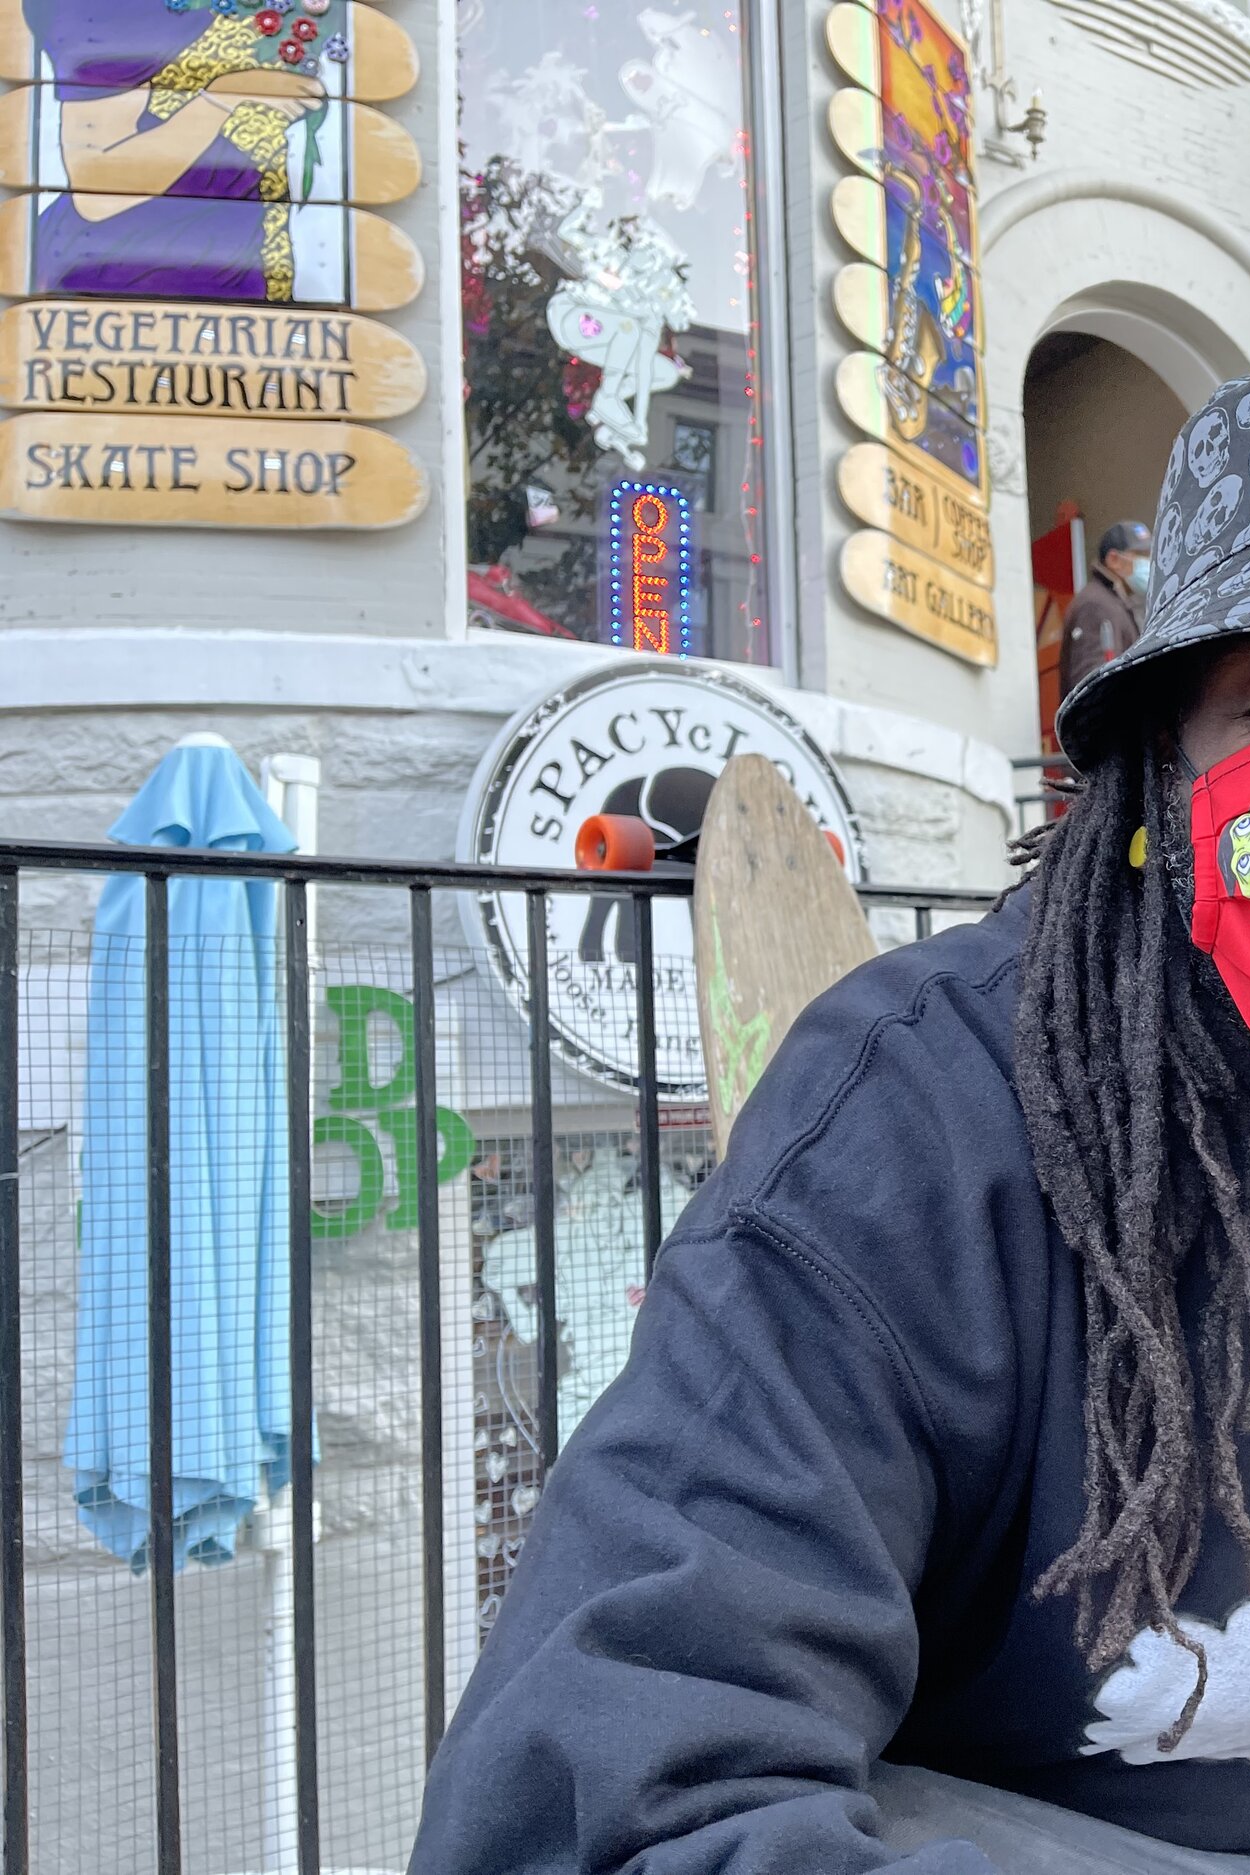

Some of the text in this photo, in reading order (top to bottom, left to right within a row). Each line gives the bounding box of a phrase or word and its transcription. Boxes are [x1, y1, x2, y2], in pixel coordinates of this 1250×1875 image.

[27, 308, 352, 363] VEGETARIAN
[25, 357, 357, 412] RESTAURANT
[26, 443, 356, 497] SKATE SHOP
[633, 494, 669, 654] OPEN
